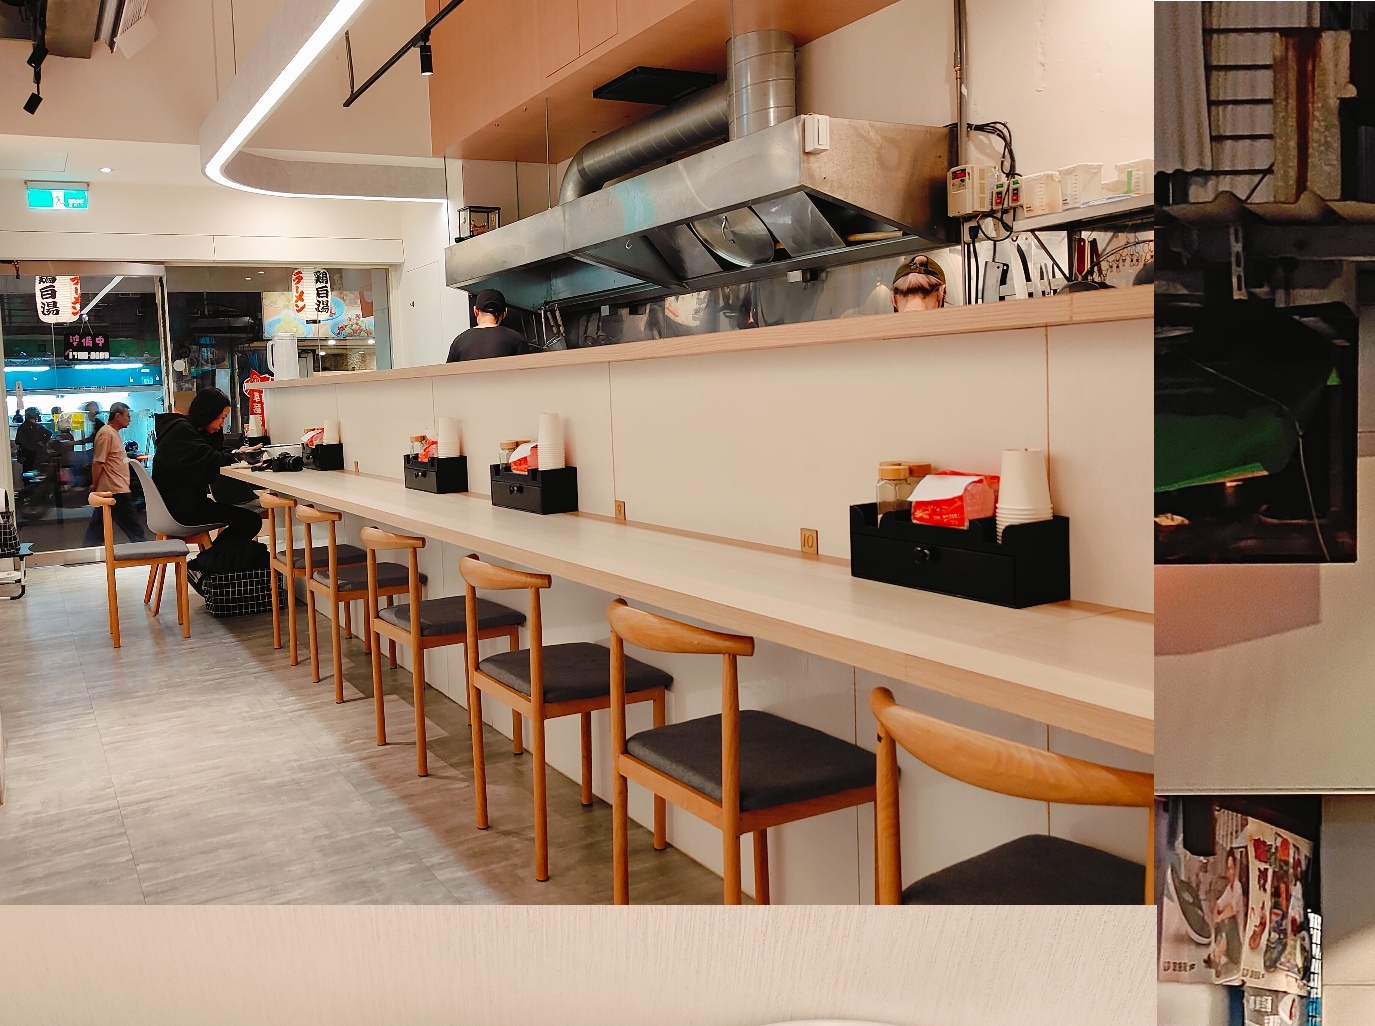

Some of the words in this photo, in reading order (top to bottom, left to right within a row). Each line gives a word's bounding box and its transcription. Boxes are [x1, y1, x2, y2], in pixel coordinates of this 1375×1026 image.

[293, 270, 307, 314] ラーメン
[803, 533, 814, 549] 10
